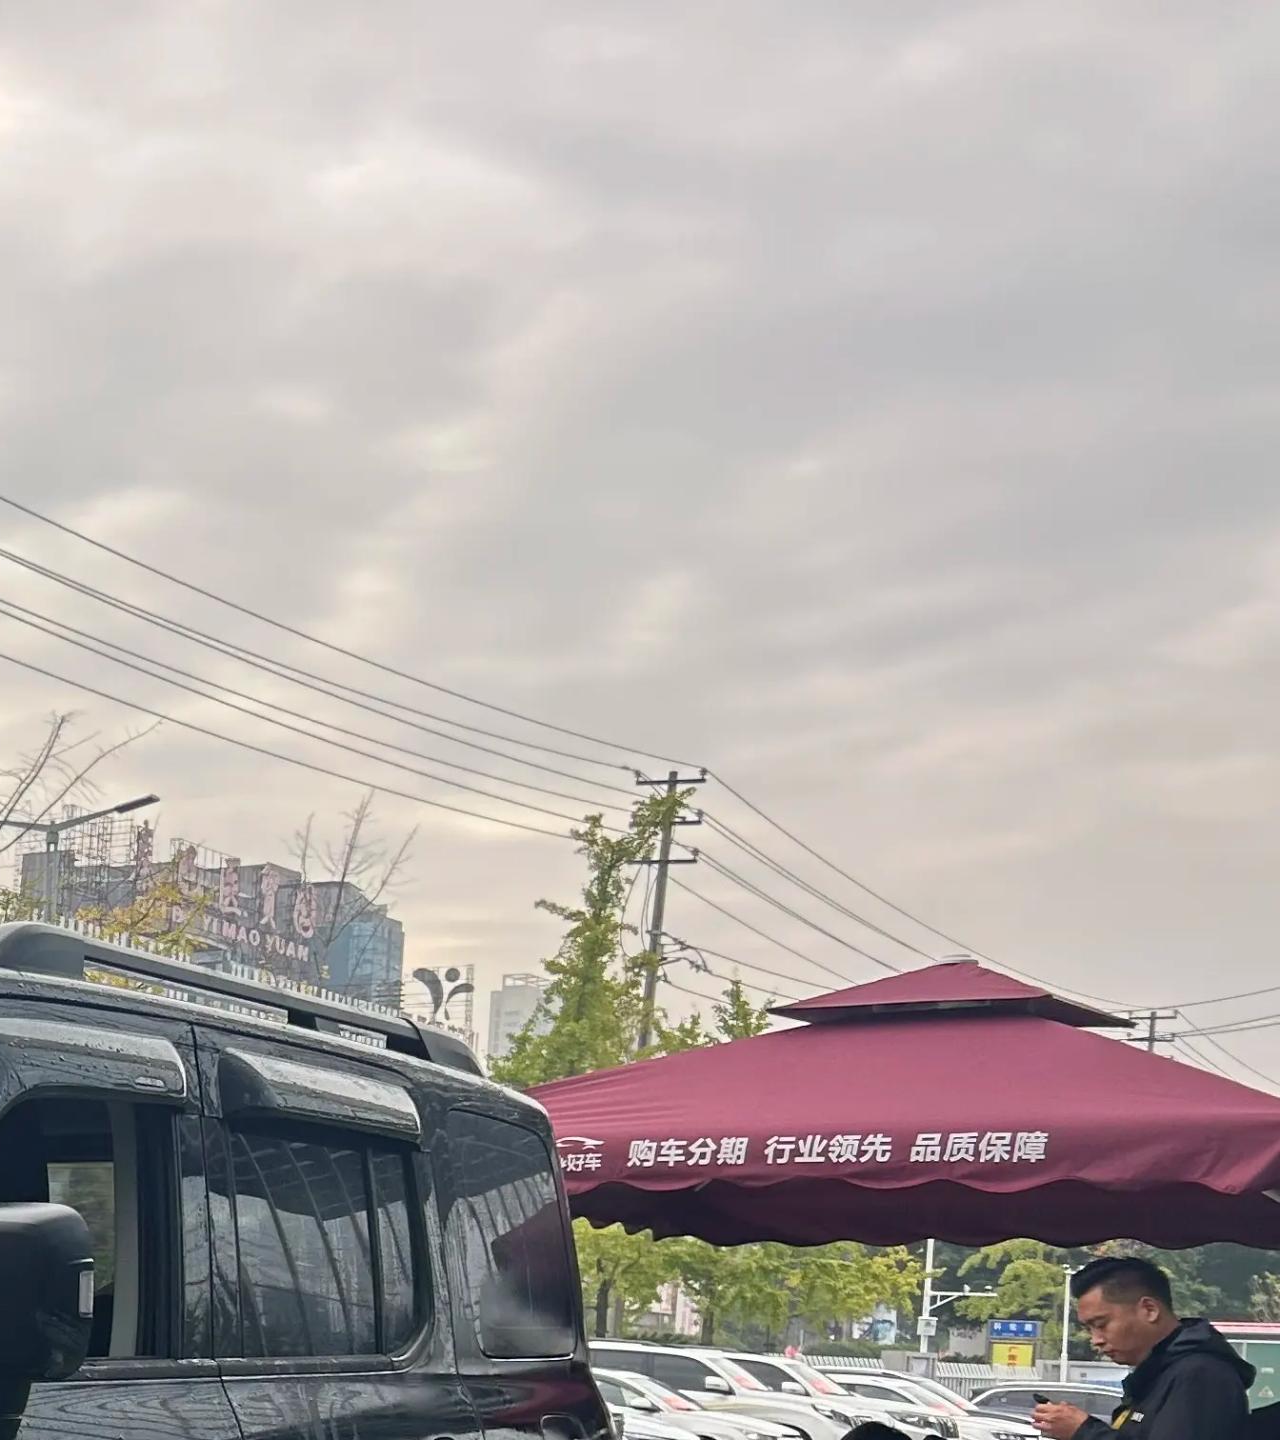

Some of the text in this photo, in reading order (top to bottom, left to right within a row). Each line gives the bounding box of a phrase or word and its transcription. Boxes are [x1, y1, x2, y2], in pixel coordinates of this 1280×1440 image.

[265, 934, 310, 963] YUAN
[627, 1131, 1049, 1168] 购车分期 行业领先 品质保障
